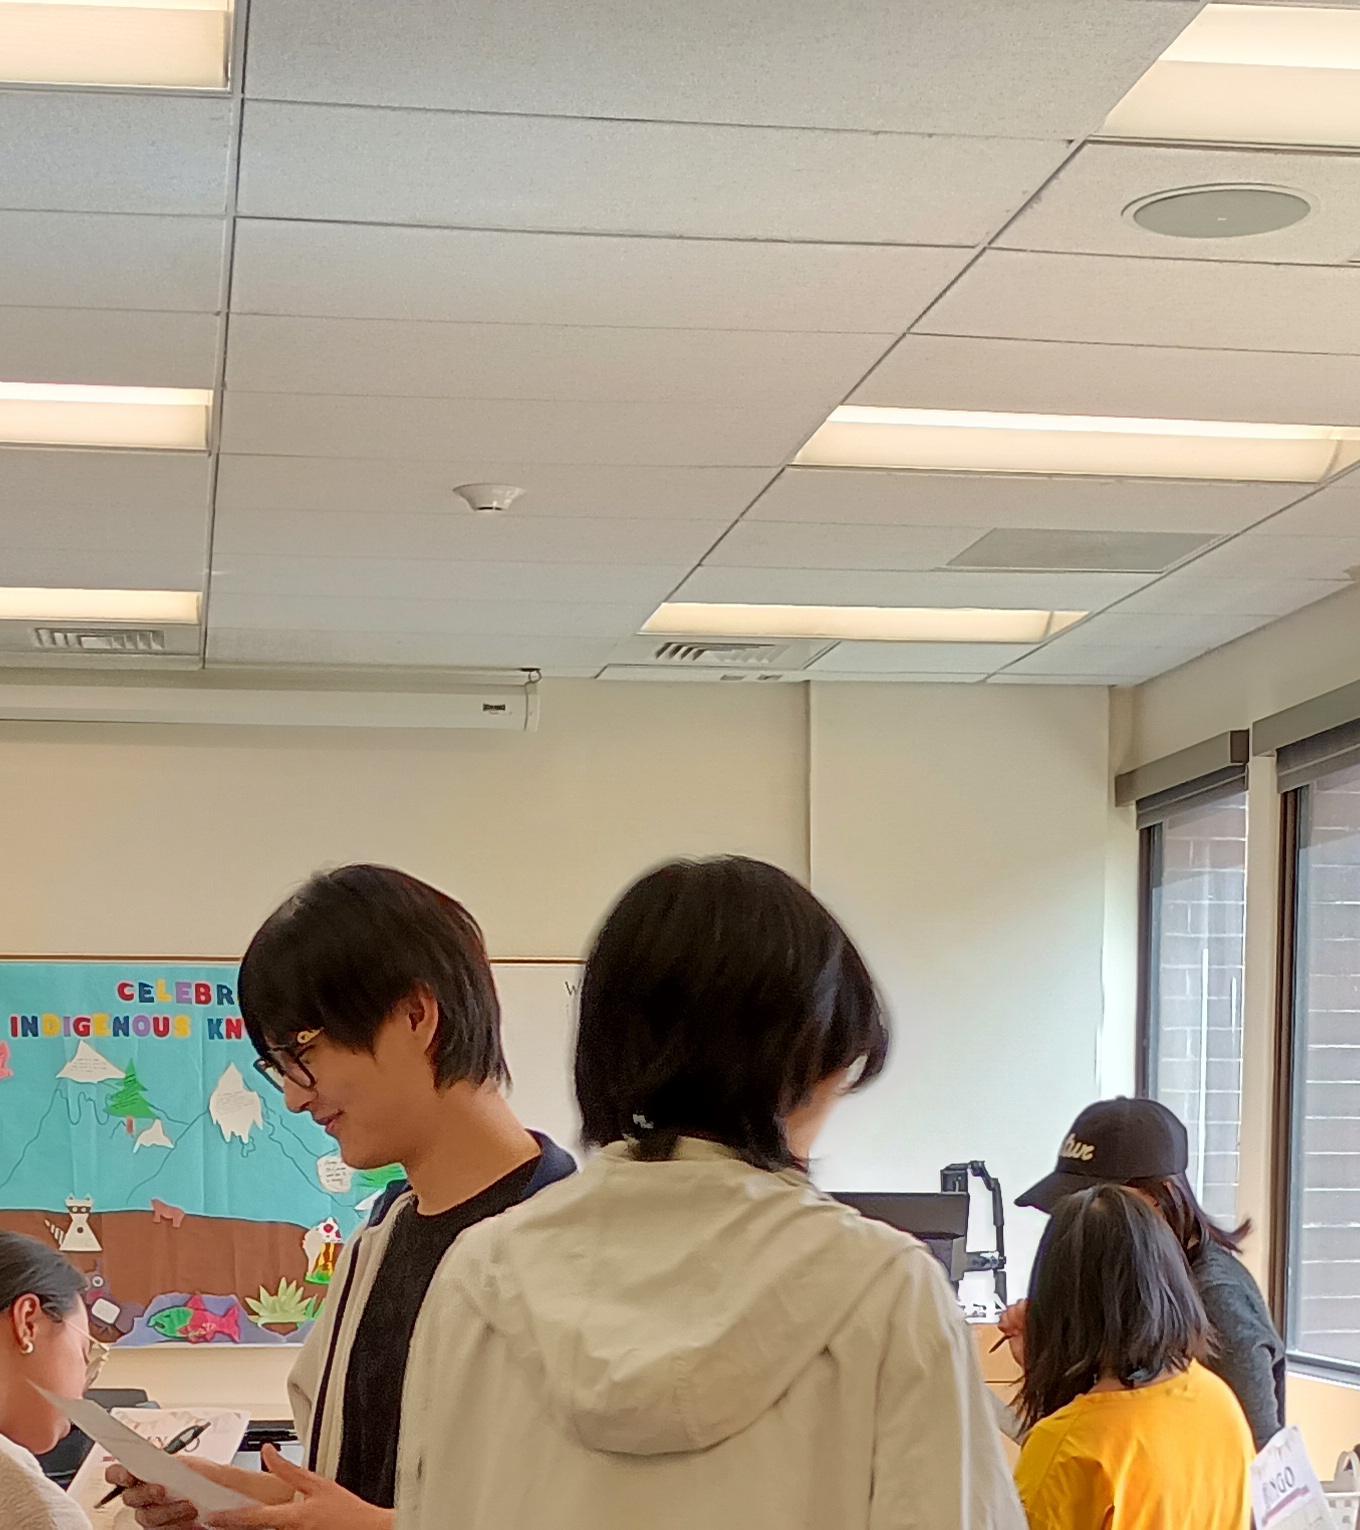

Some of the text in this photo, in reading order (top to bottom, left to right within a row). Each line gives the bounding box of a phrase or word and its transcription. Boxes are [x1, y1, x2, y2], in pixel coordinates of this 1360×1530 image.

[117, 979, 238, 1005] CELEBR
[10, 1013, 244, 1040] INDIGENOUS KN
